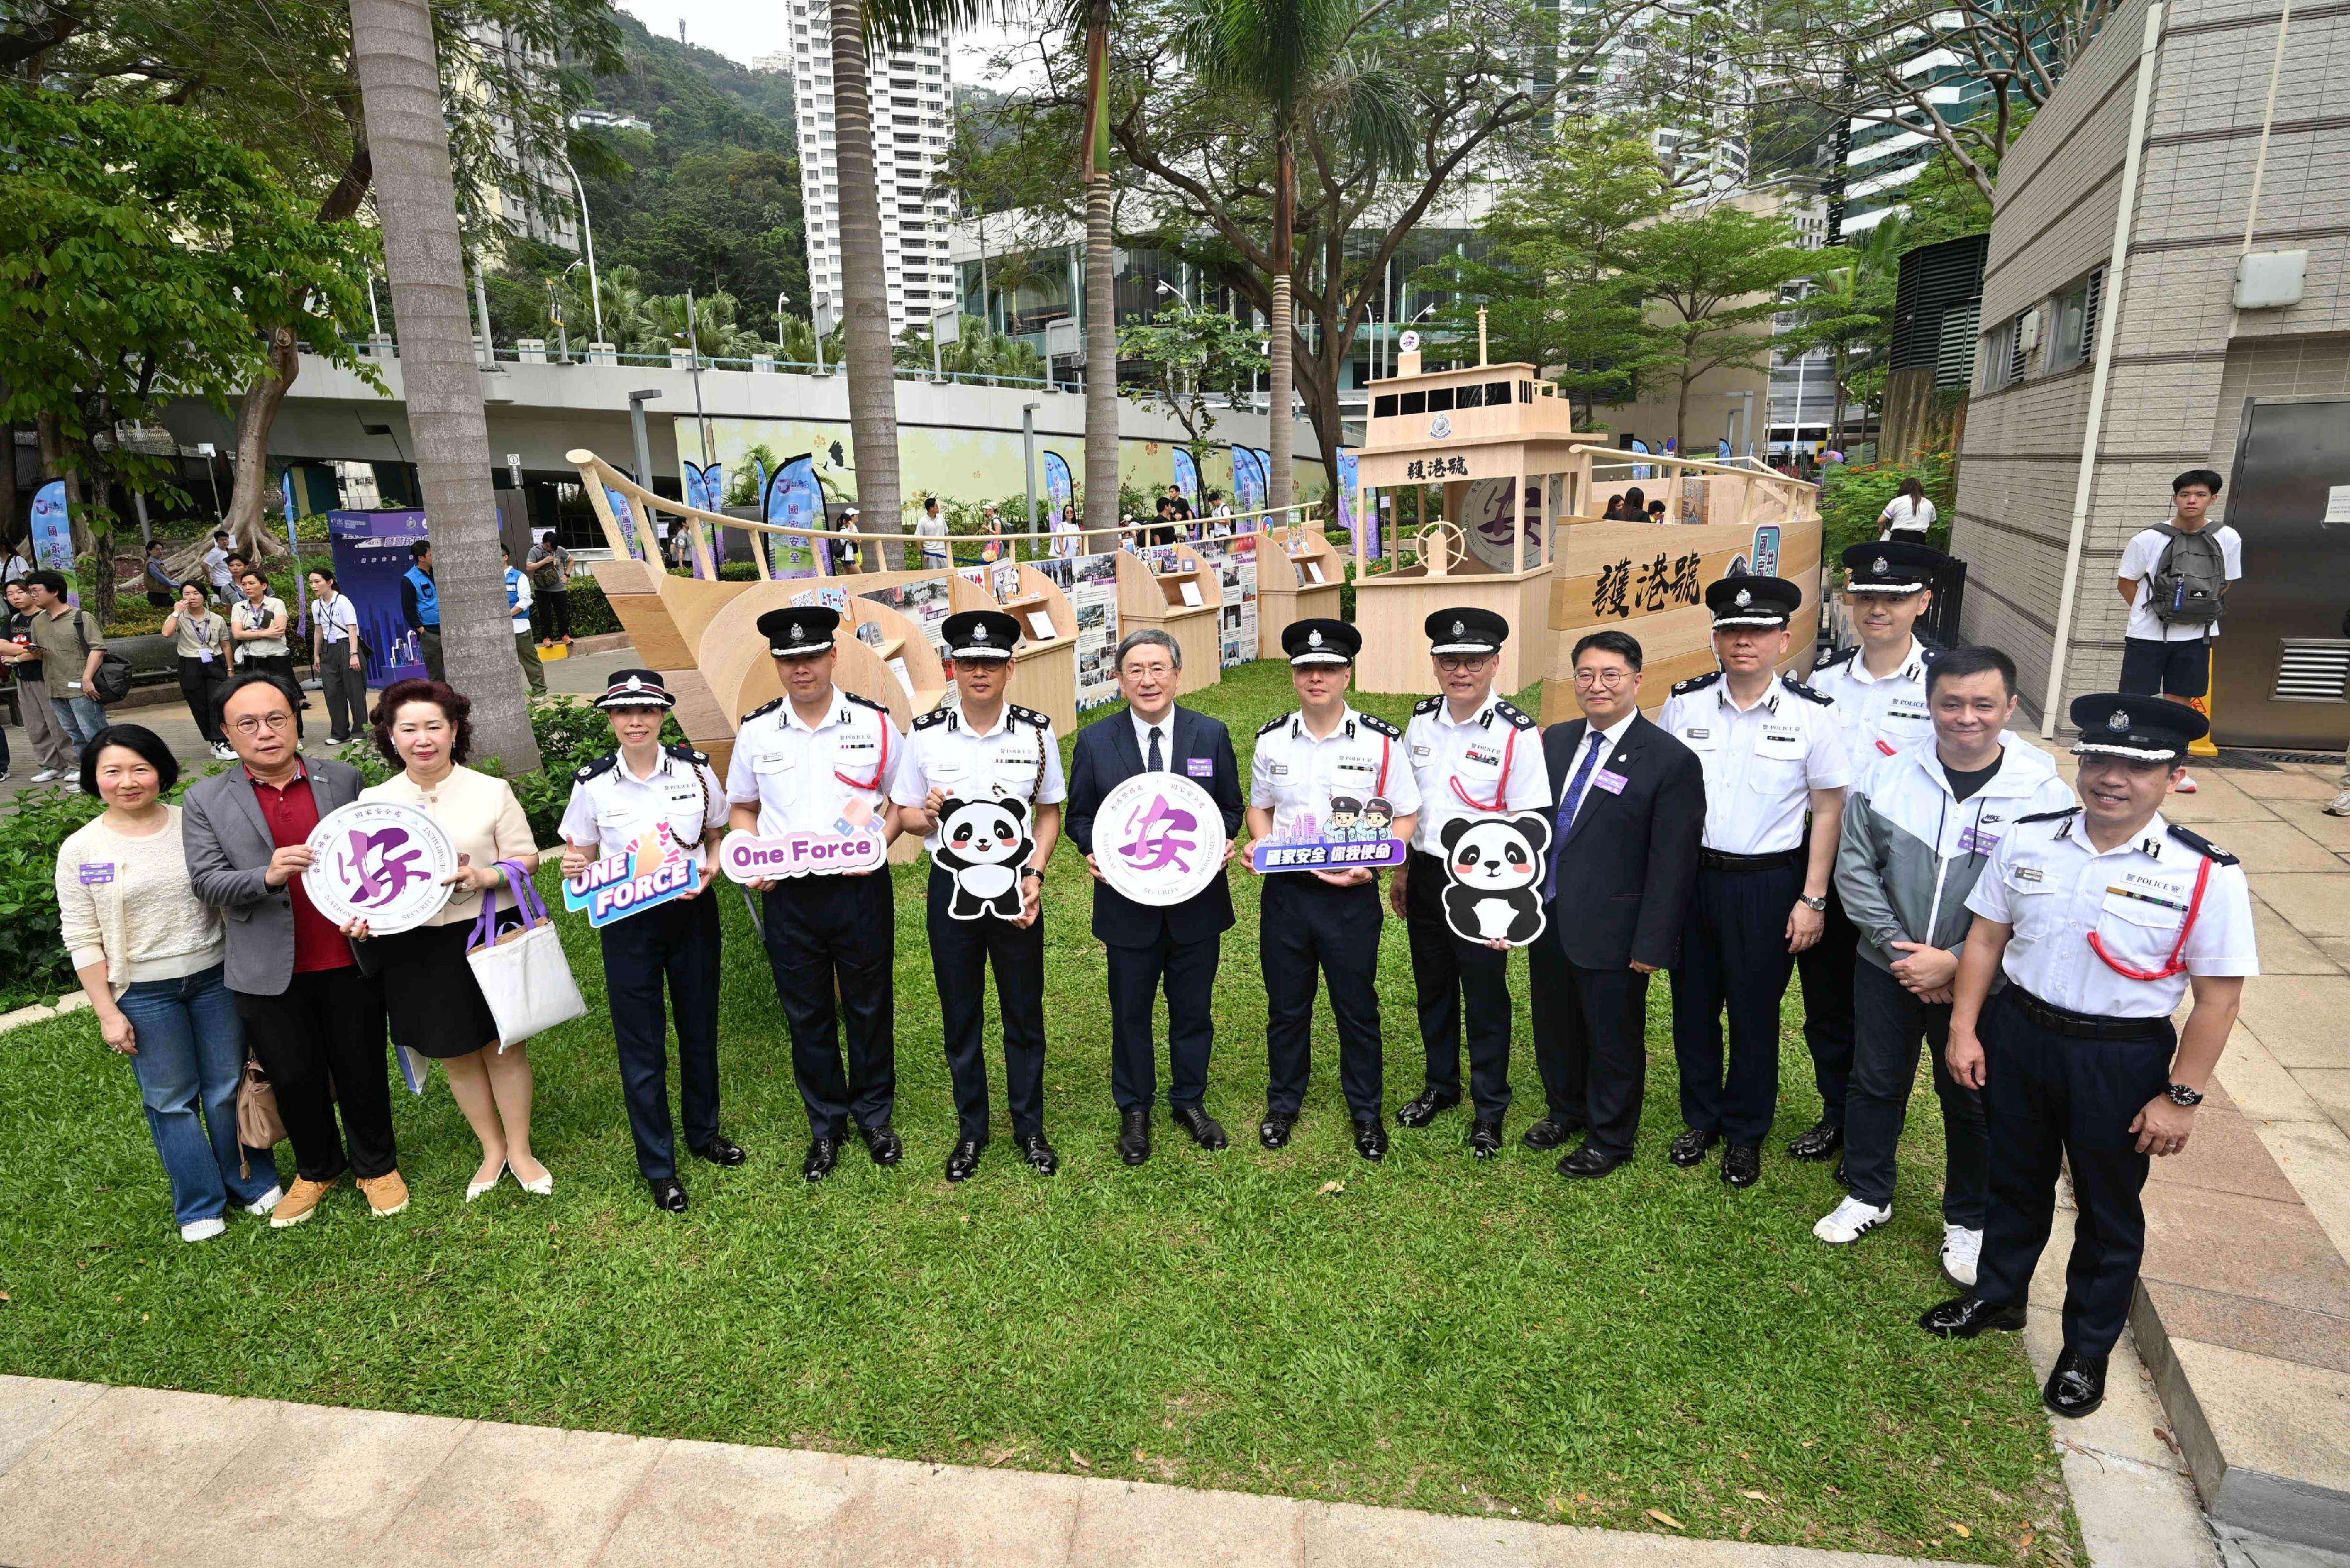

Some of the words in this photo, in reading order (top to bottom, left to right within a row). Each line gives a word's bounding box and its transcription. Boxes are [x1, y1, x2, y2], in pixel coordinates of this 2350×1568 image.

[1407, 455, 1468, 481] 護港號
[788, 503, 800, 564] 國家安全
[47, 526, 62, 570] 國家安
[1499, 558, 1533, 568] SECITY
[1592, 548, 1701, 618] 護港號
[821, 592, 844, 608] 上下一心
[1900, 699, 1925, 708] POLICE
[1477, 745, 1495, 753] POLICE
[354, 807, 402, 818] 國家安全處
[1117, 794, 1197, 874] 安
[421, 827, 446, 873] DEPARTMENT
[733, 846, 784, 867] One
[792, 840, 871, 861] Force
[1102, 832, 1117, 870] NATIONAL
[1197, 830, 1216, 877] DEPARTMENT
[1265, 847, 1328, 867] 國家安全
[1330, 843, 1393, 864] 你我使命
[570, 852, 629, 897] ONE
[2136, 876, 2170, 890] POLICE
[596, 859, 691, 919] FORCE
[1143, 887, 1179, 896] SECURITY
[401, 895, 436, 921] SECURITY
